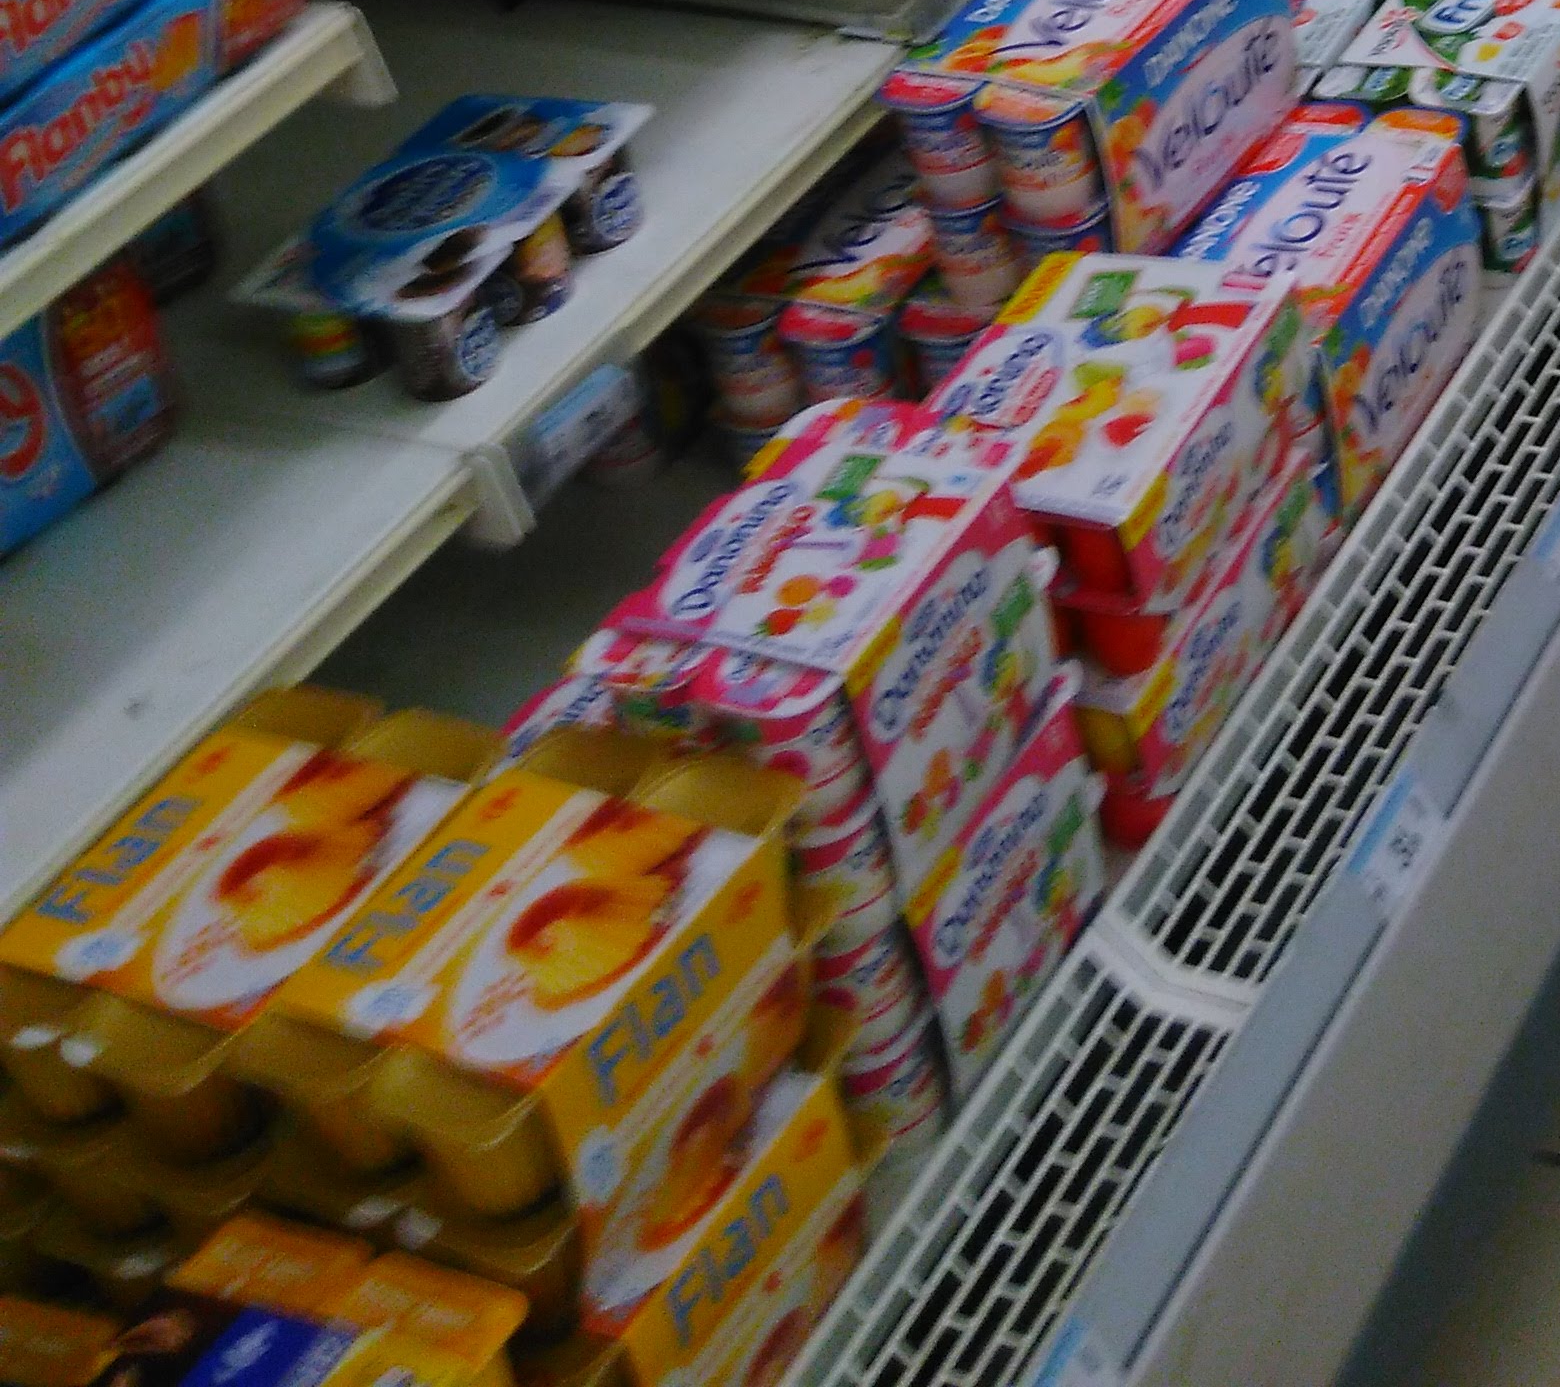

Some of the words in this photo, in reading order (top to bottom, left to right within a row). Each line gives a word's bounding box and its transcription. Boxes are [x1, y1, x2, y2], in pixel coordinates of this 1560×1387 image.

[36, 794, 203, 926] Flan
[326, 837, 492, 975] Flan
[584, 931, 722, 1108] Flan
[664, 1173, 793, 1348] Flan
